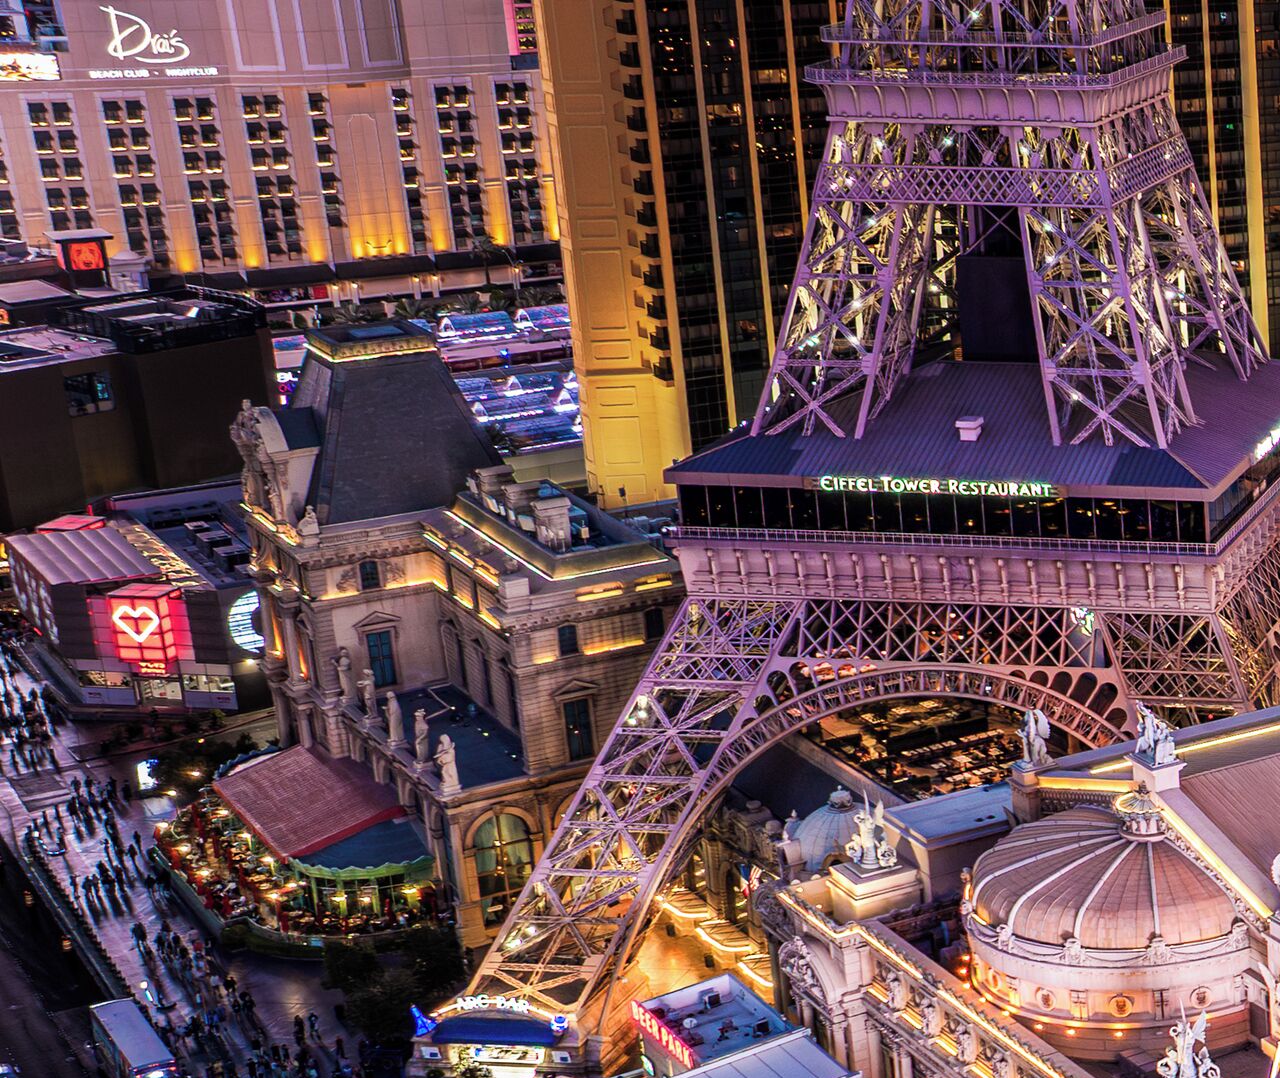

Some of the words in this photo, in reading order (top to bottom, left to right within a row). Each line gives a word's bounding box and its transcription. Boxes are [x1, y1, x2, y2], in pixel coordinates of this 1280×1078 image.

[100, 5, 190, 63] Drai's
[89, 70, 123, 79] BEACH
[124, 69, 150, 78] CLUB
[165, 67, 218, 77] NIGHTCLUB
[820, 475, 877, 493] EIFFEL
[880, 476, 941, 494] TOWER
[948, 479, 1052, 498] RESTAURANT
[456, 993, 490, 1012] ARC
[496, 995, 530, 1014] BAR
[631, 1001, 660, 1041] BEER
[660, 1026, 692, 1070] PARK
